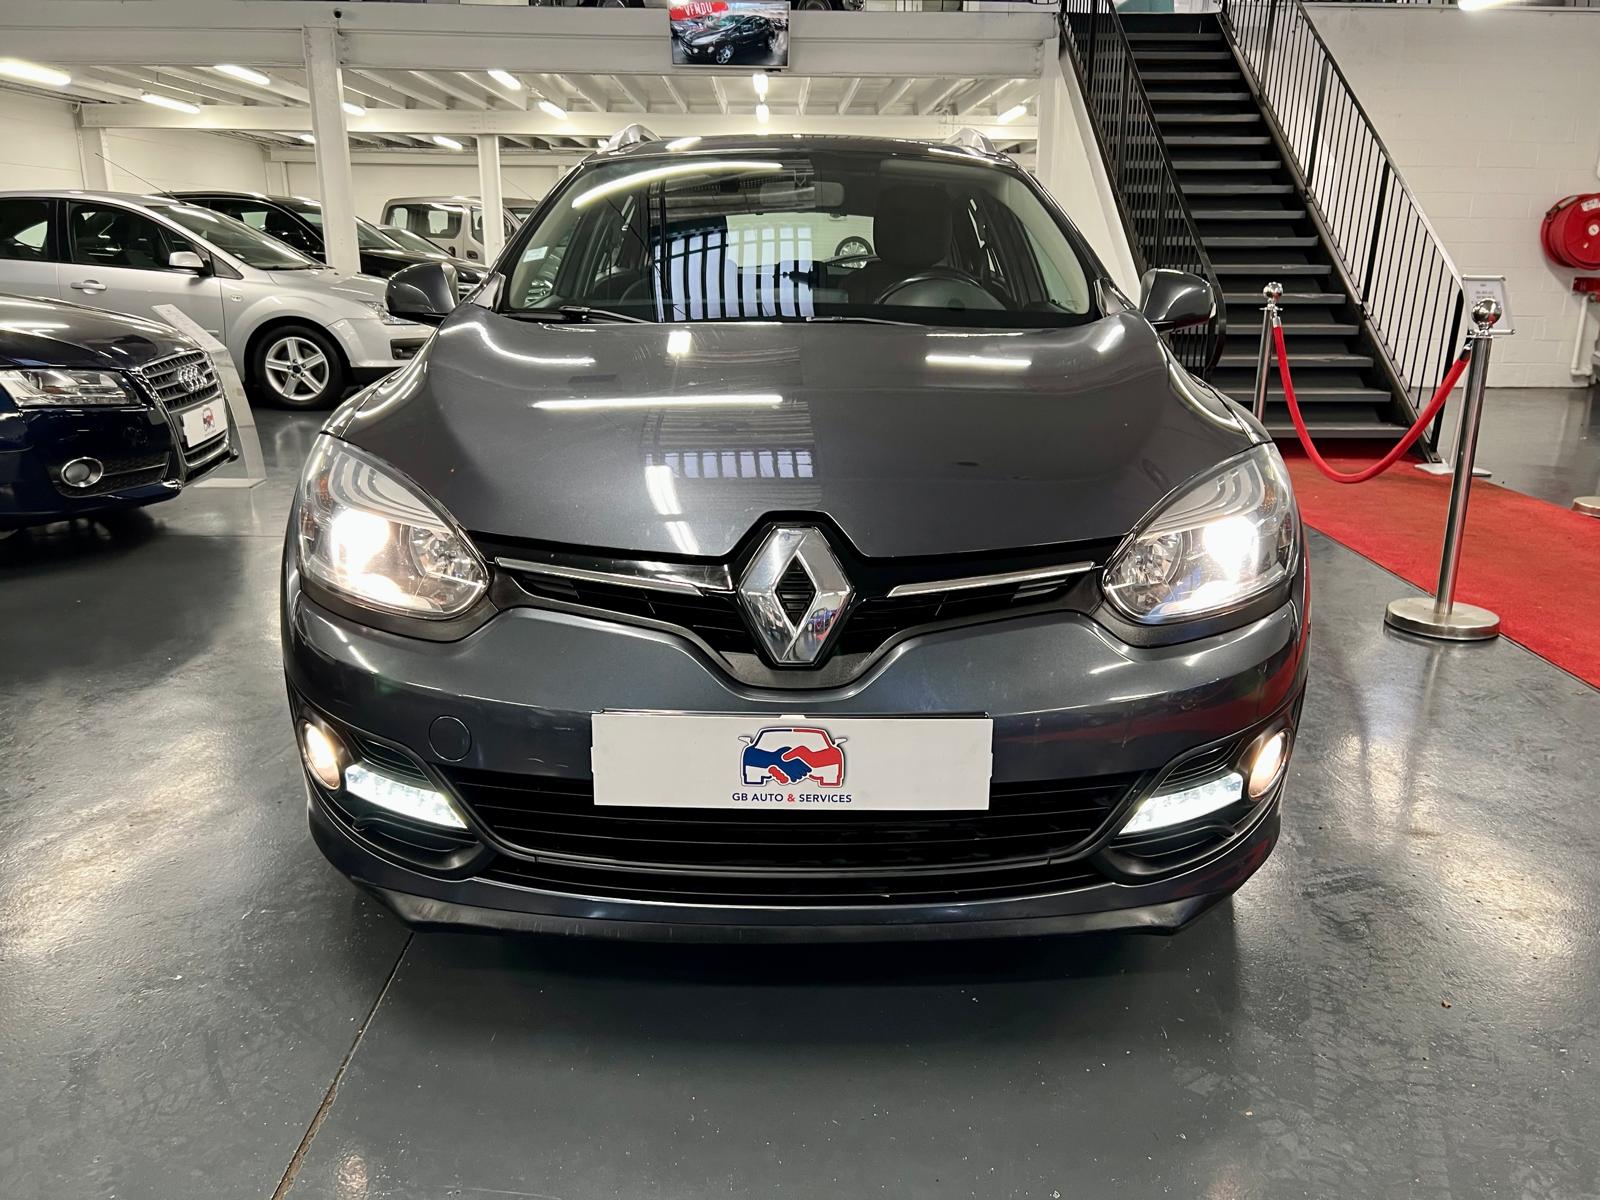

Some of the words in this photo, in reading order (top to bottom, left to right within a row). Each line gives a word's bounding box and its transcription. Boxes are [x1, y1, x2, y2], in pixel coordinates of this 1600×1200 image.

[684, 2, 713, 16] VENDU
[732, 792, 748, 802] GB
[751, 793, 784, 802] AUTO
[787, 793, 796, 802] &
[799, 794, 852, 803] SERVICES
